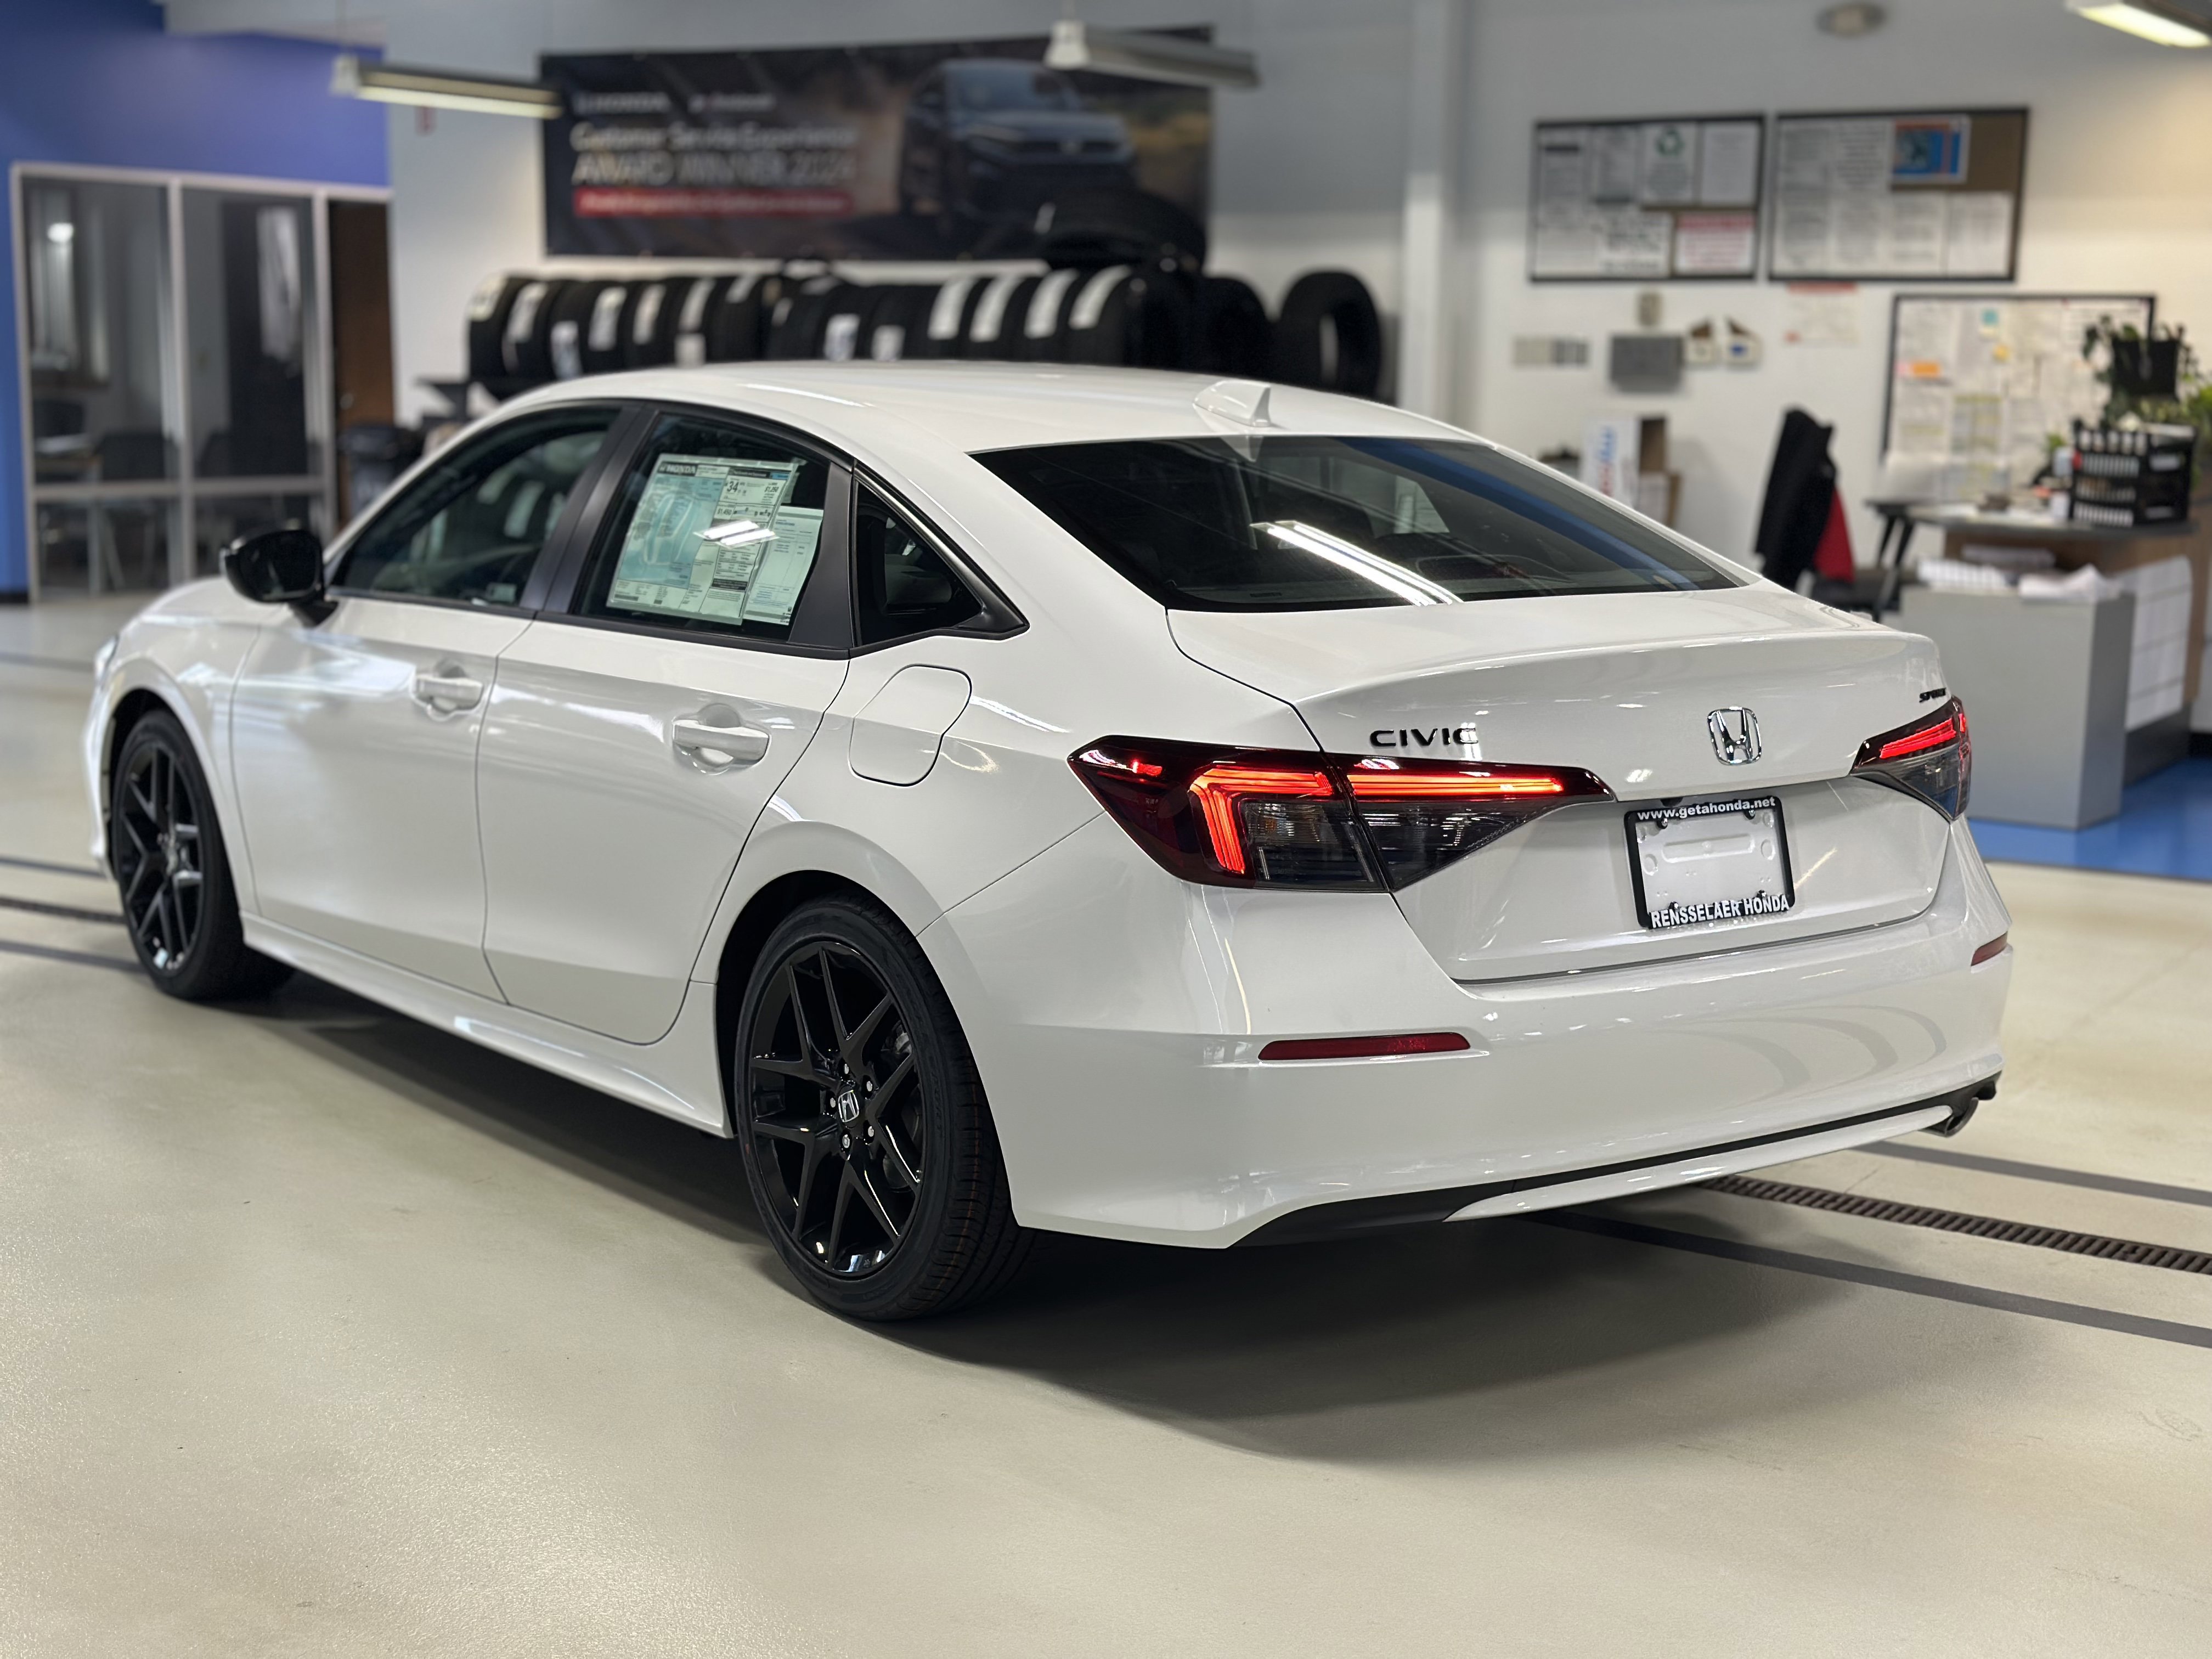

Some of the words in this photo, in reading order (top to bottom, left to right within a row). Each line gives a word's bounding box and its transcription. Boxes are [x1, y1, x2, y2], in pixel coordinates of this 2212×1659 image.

[572, 153, 674, 185] AWARD
[667, 463, 696, 474] HONDA
[727, 481, 739, 493] 34
[1370, 728, 1478, 747] CIVIC
[1638, 797, 1776, 820] www.getahonda.net
[1651, 900, 1741, 928] RENSSELAER
[1744, 895, 1790, 915] HONDA
